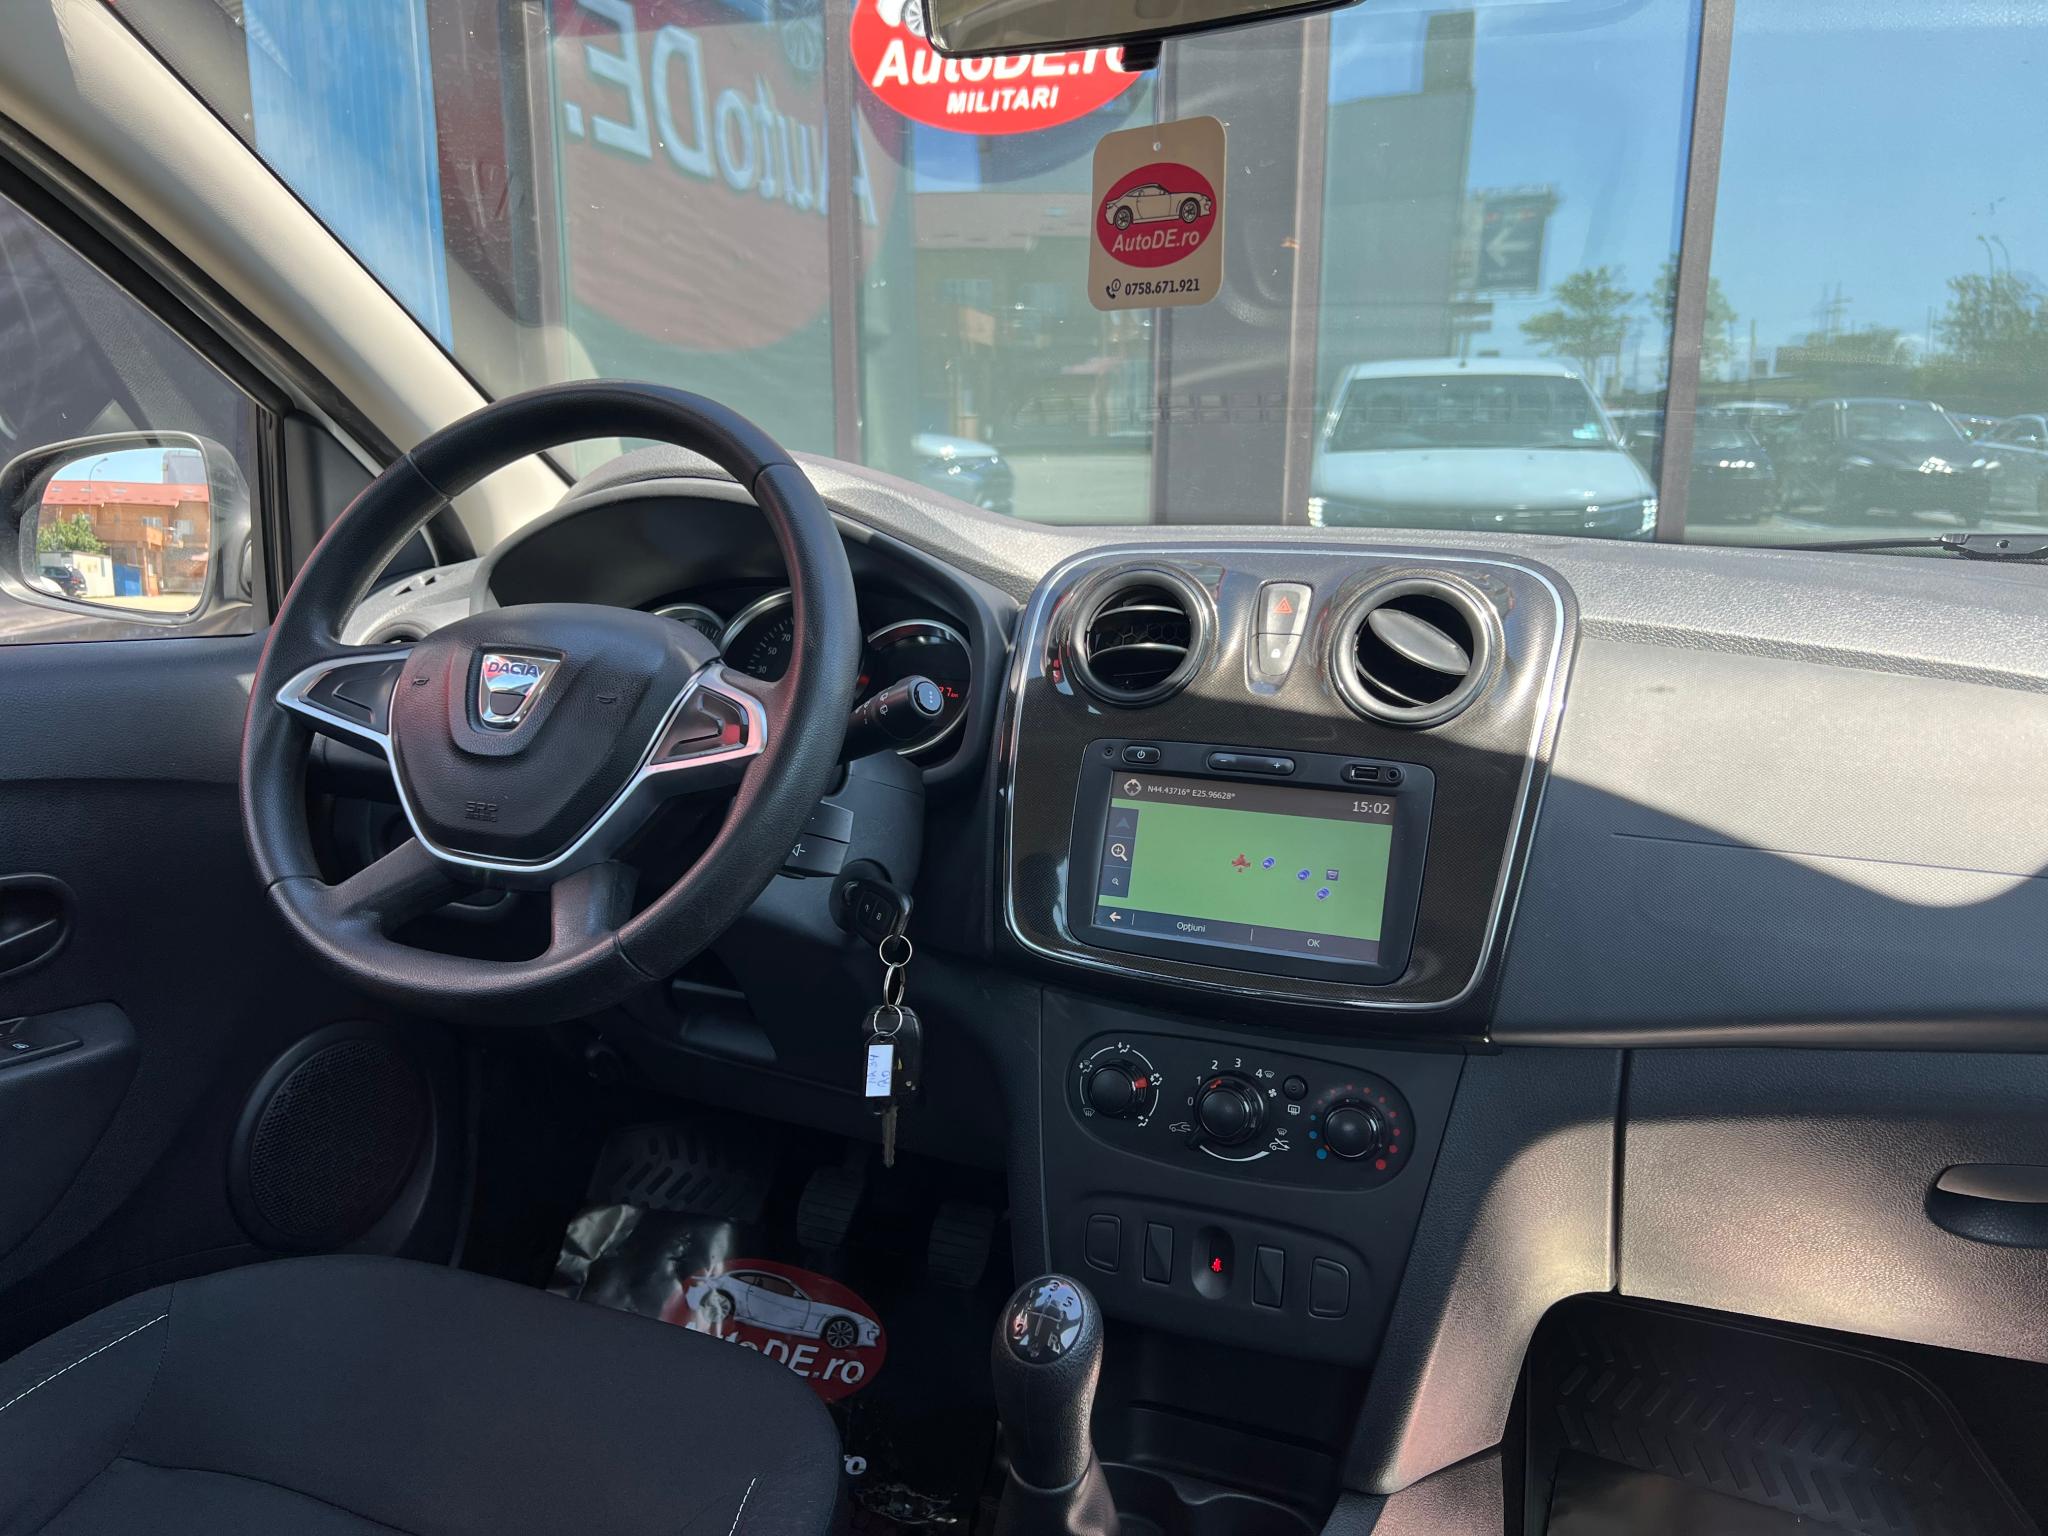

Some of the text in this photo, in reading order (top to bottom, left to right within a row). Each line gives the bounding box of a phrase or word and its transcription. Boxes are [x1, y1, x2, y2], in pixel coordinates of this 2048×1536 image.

[946, 85, 1059, 114] MILITARI
[1112, 228, 1200, 253] AutoDE.ro
[1125, 279, 1200, 296] 0758.671.921
[488, 661, 540, 677] DACIA
[1352, 801, 1391, 815] 15:02
[1306, 938, 1321, 948] OK
[1211, 1060, 1219, 1070] 2
[1234, 1058, 1242, 1068] 3
[1255, 1068, 1263, 1079] 4
[1062, 1296, 1074, 1308] 5
